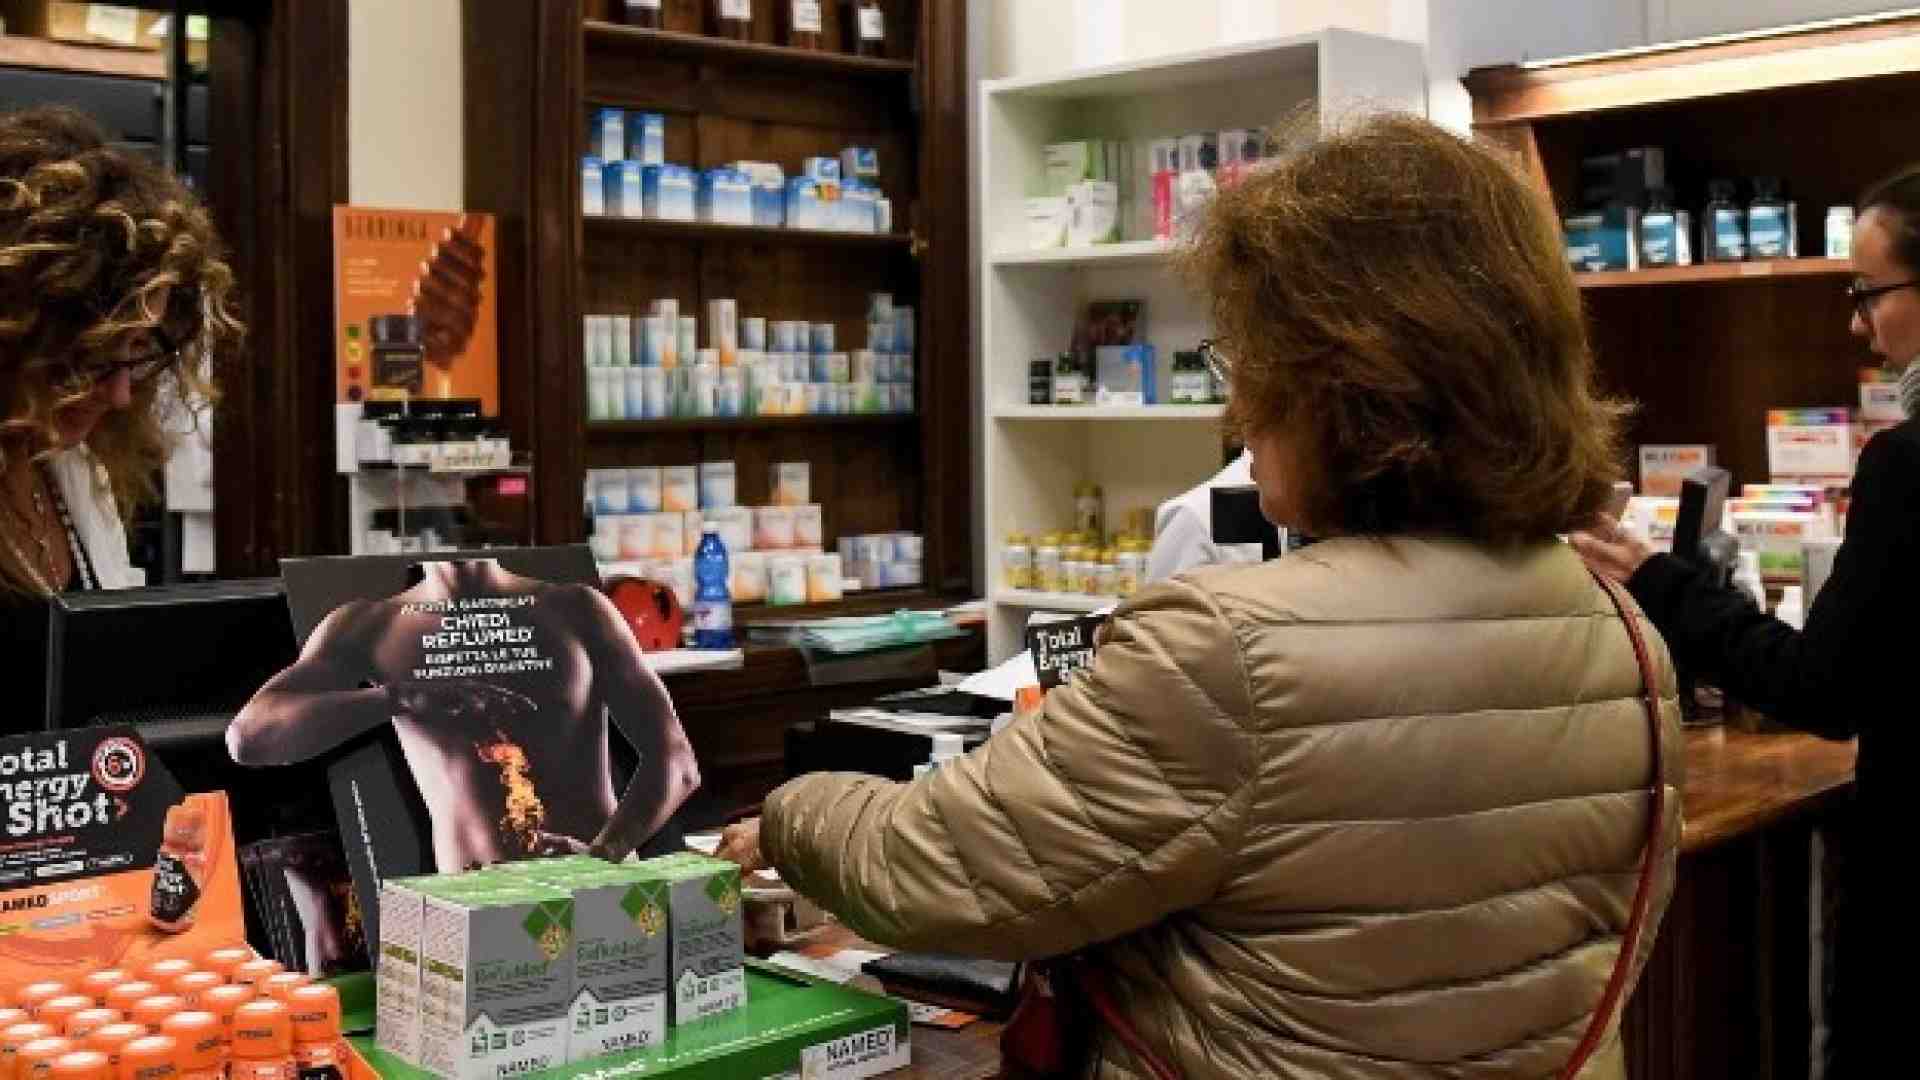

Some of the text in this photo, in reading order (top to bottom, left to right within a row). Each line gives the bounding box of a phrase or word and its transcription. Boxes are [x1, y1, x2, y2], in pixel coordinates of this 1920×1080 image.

[440, 612, 511, 631] CHIEDI
[0, 739, 69, 776] otal
[5, 792, 110, 837] Shot
